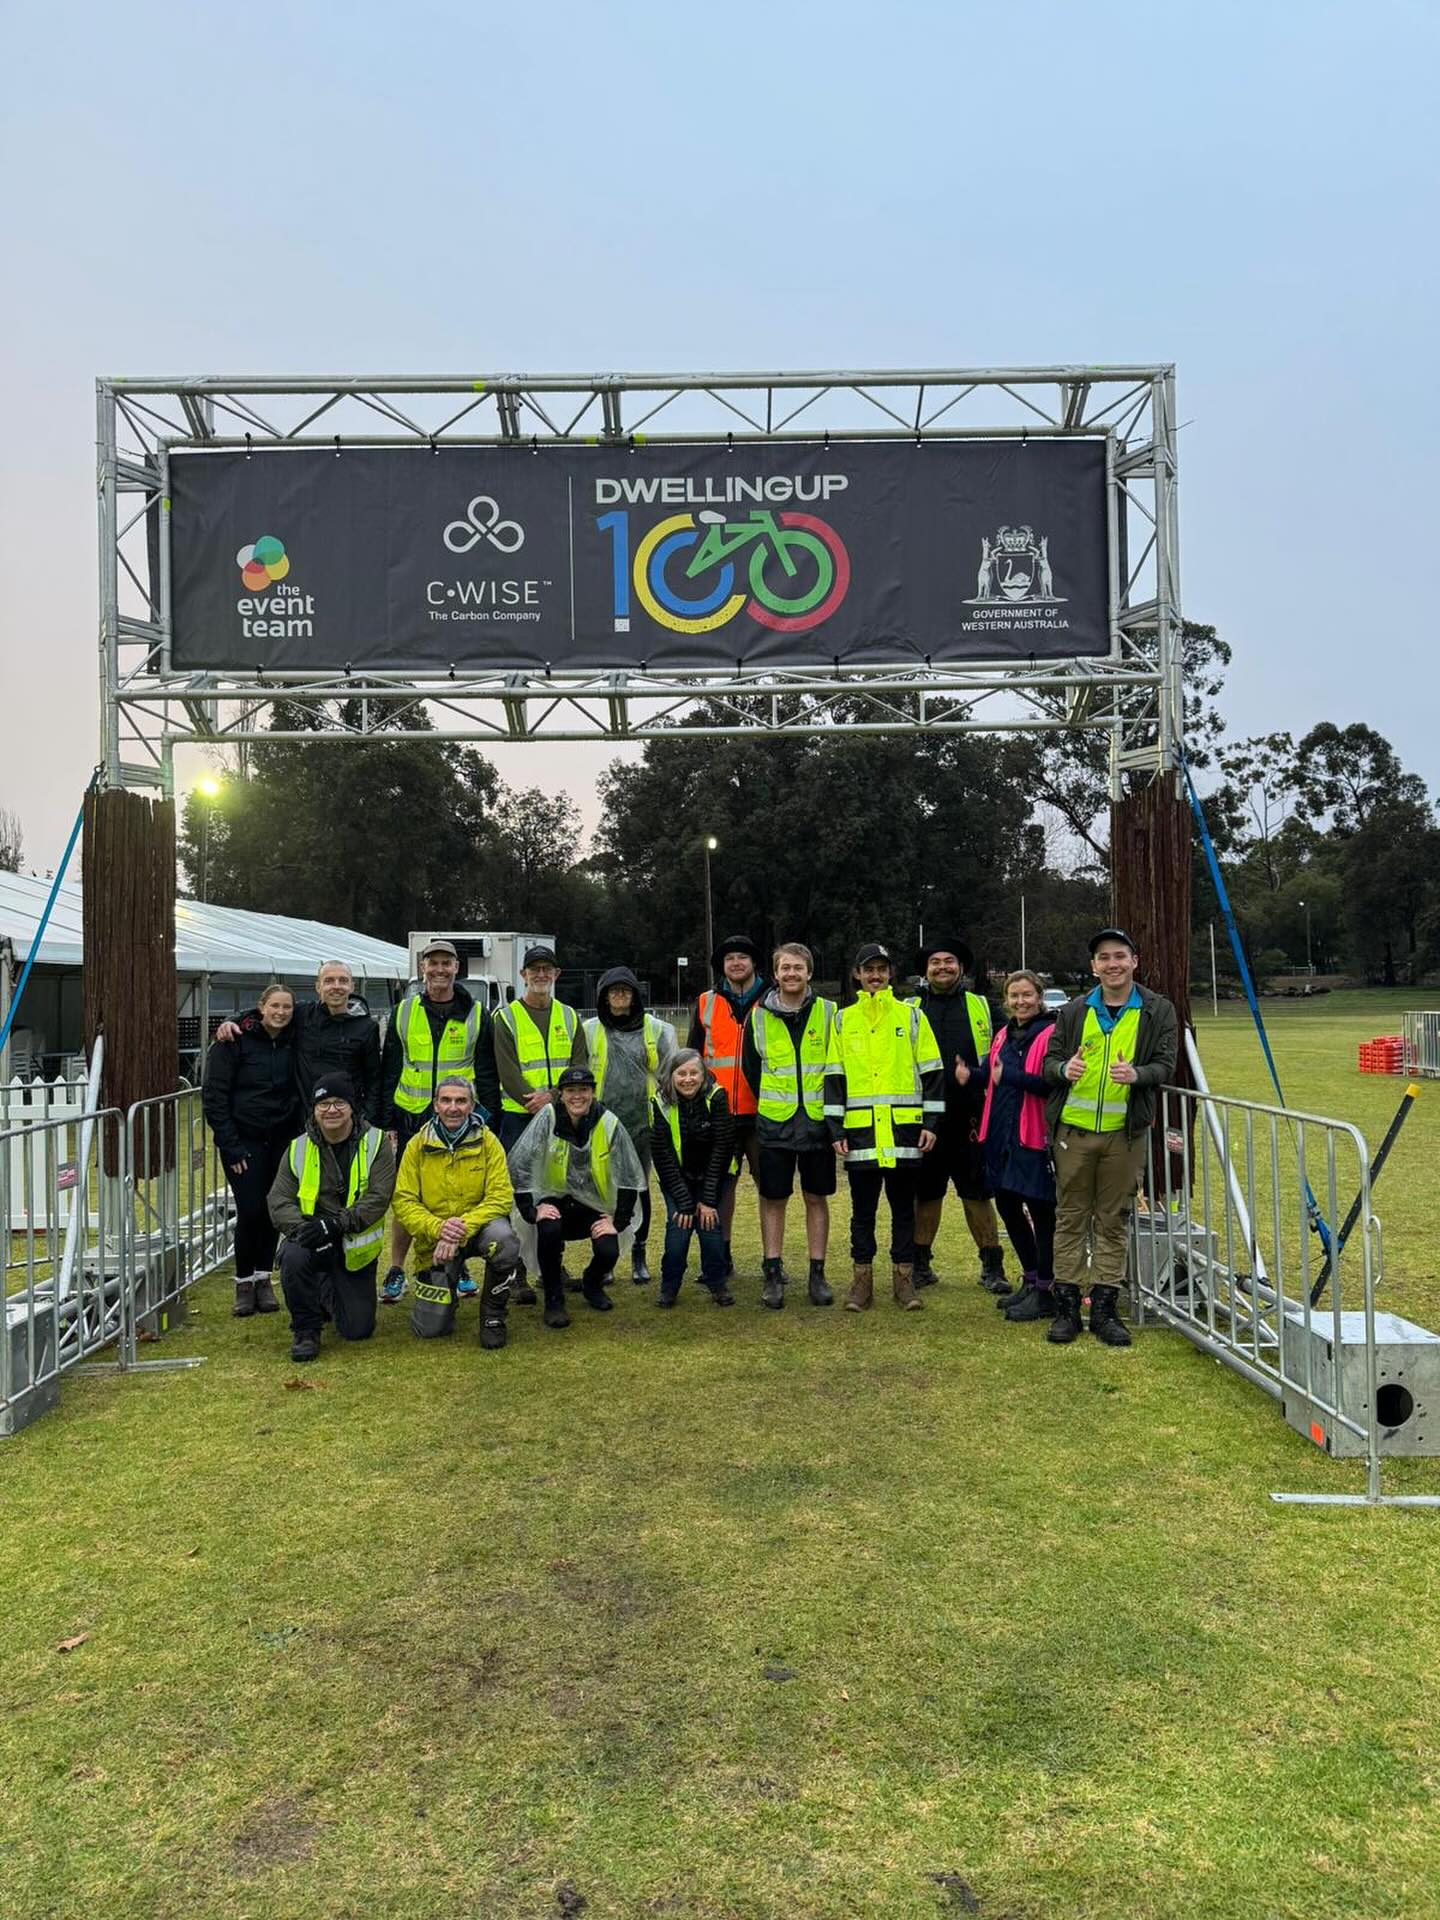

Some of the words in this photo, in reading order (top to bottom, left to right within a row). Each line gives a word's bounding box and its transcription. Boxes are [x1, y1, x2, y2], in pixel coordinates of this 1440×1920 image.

[595, 475, 849, 504] DWELLINGUP
[596, 510, 850, 634] 100
[276, 583, 300, 596] the
[237, 595, 315, 616] event
[972, 608, 1043, 619] GOVERNMENT
[1044, 608, 1059, 617] OF
[428, 611, 448, 620] The
[451, 611, 489, 620] Carbon
[492, 611, 541, 622] Company
[242, 617, 313, 637] team
[961, 621, 1012, 631] WESTERN
[1013, 620, 1069, 629] AUSTRALIA
